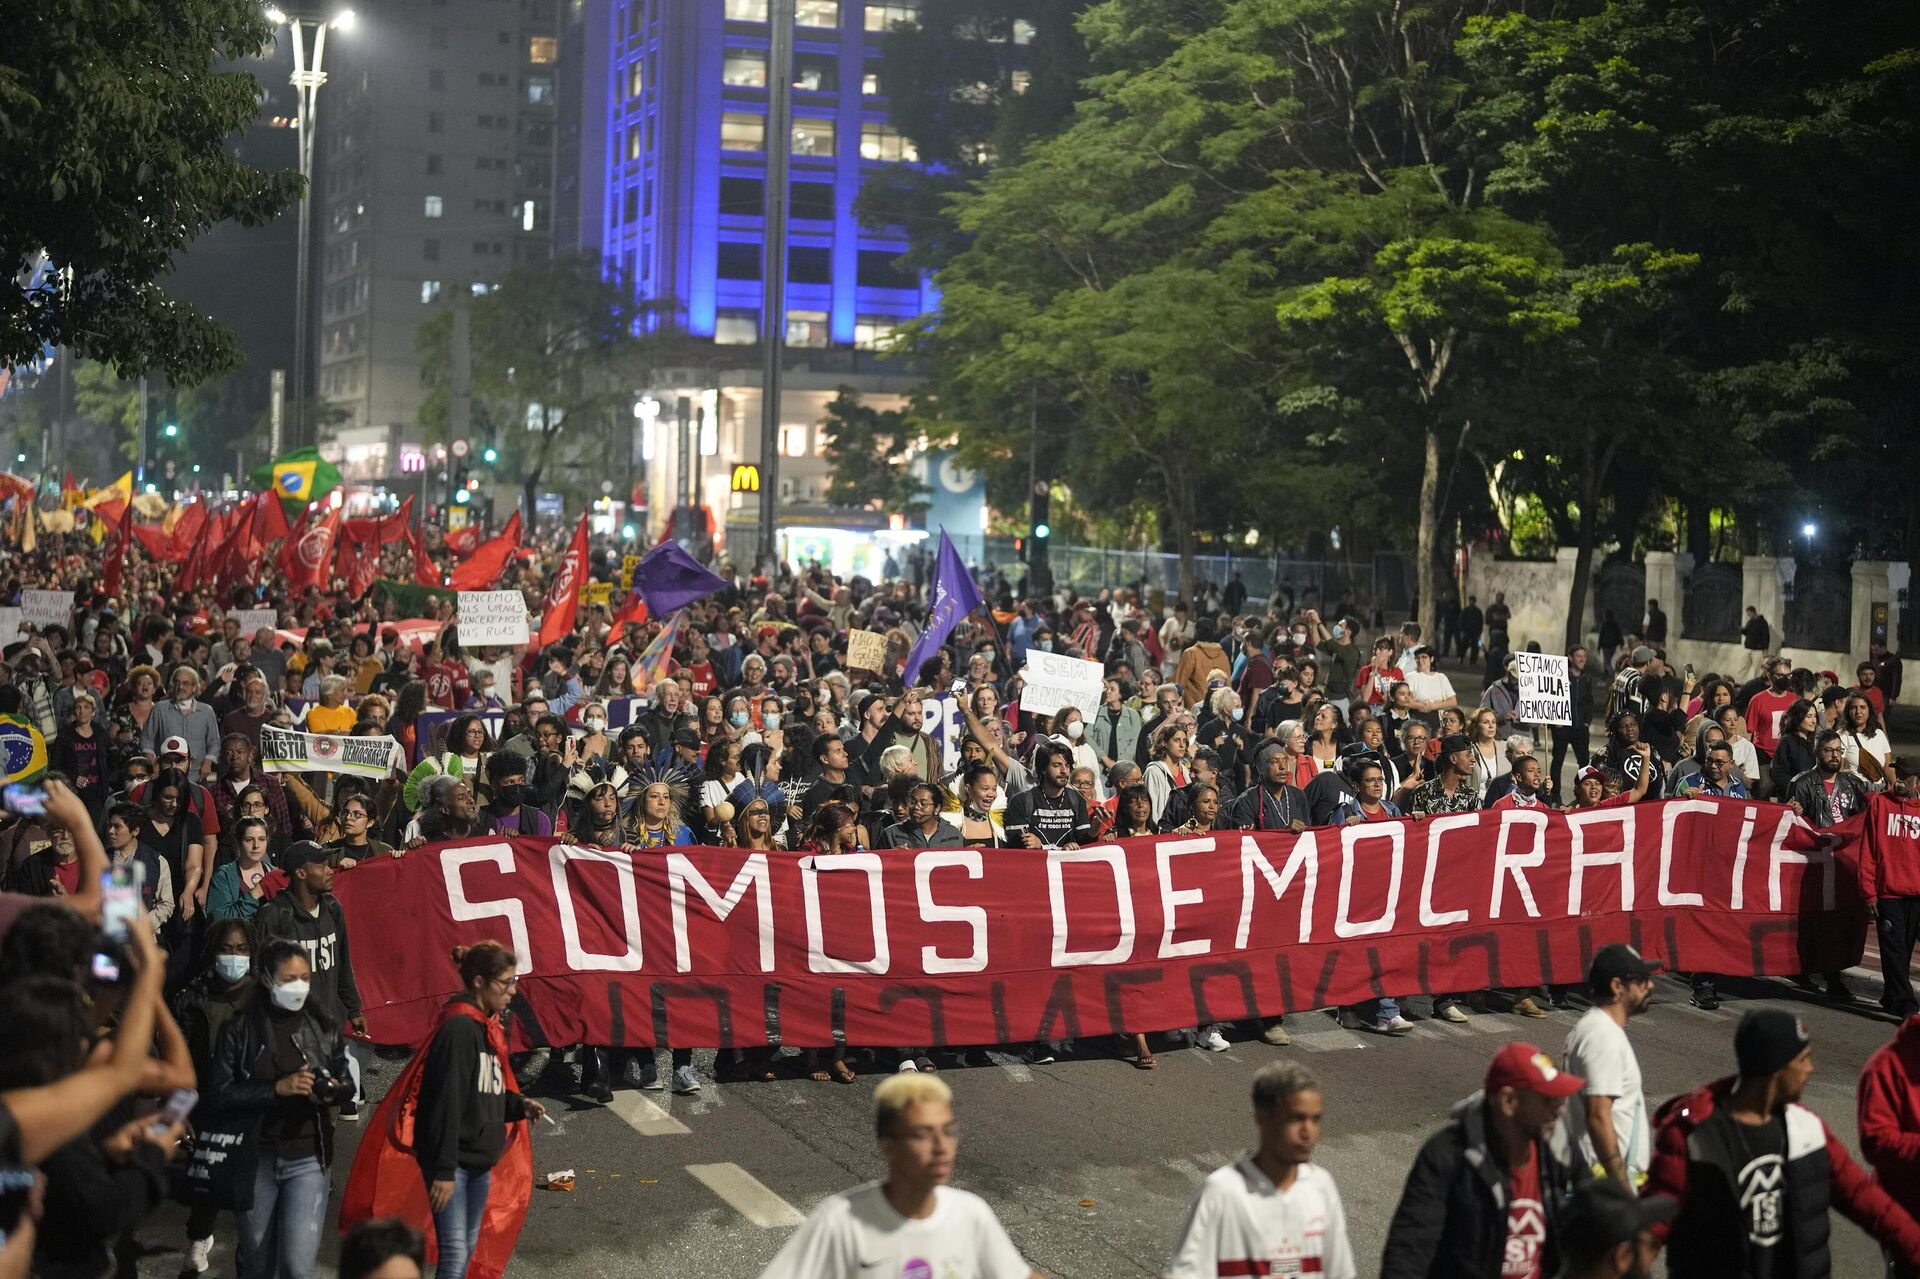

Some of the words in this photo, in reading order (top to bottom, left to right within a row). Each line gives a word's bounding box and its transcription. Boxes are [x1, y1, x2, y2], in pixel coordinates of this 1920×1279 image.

[459, 592, 522, 602] VENCEMOS
[459, 605, 478, 613] NAS
[458, 615, 520, 625] VENCEREMOS
[460, 627, 478, 639] NAS
[487, 626, 514, 637] RUAS
[1043, 656, 1088, 681] SEM
[1518, 654, 1563, 678] ESTAMOS
[1519, 675, 1535, 688] COM
[1537, 675, 1565, 697] LULA
[1520, 700, 1572, 721] DEMOCRACIA
[261, 730, 305, 741] SEM
[262, 741, 308, 760] ANISTIA
[342, 744, 391, 768] DEMOCRACIA
[440, 842, 988, 975] SOMOS
